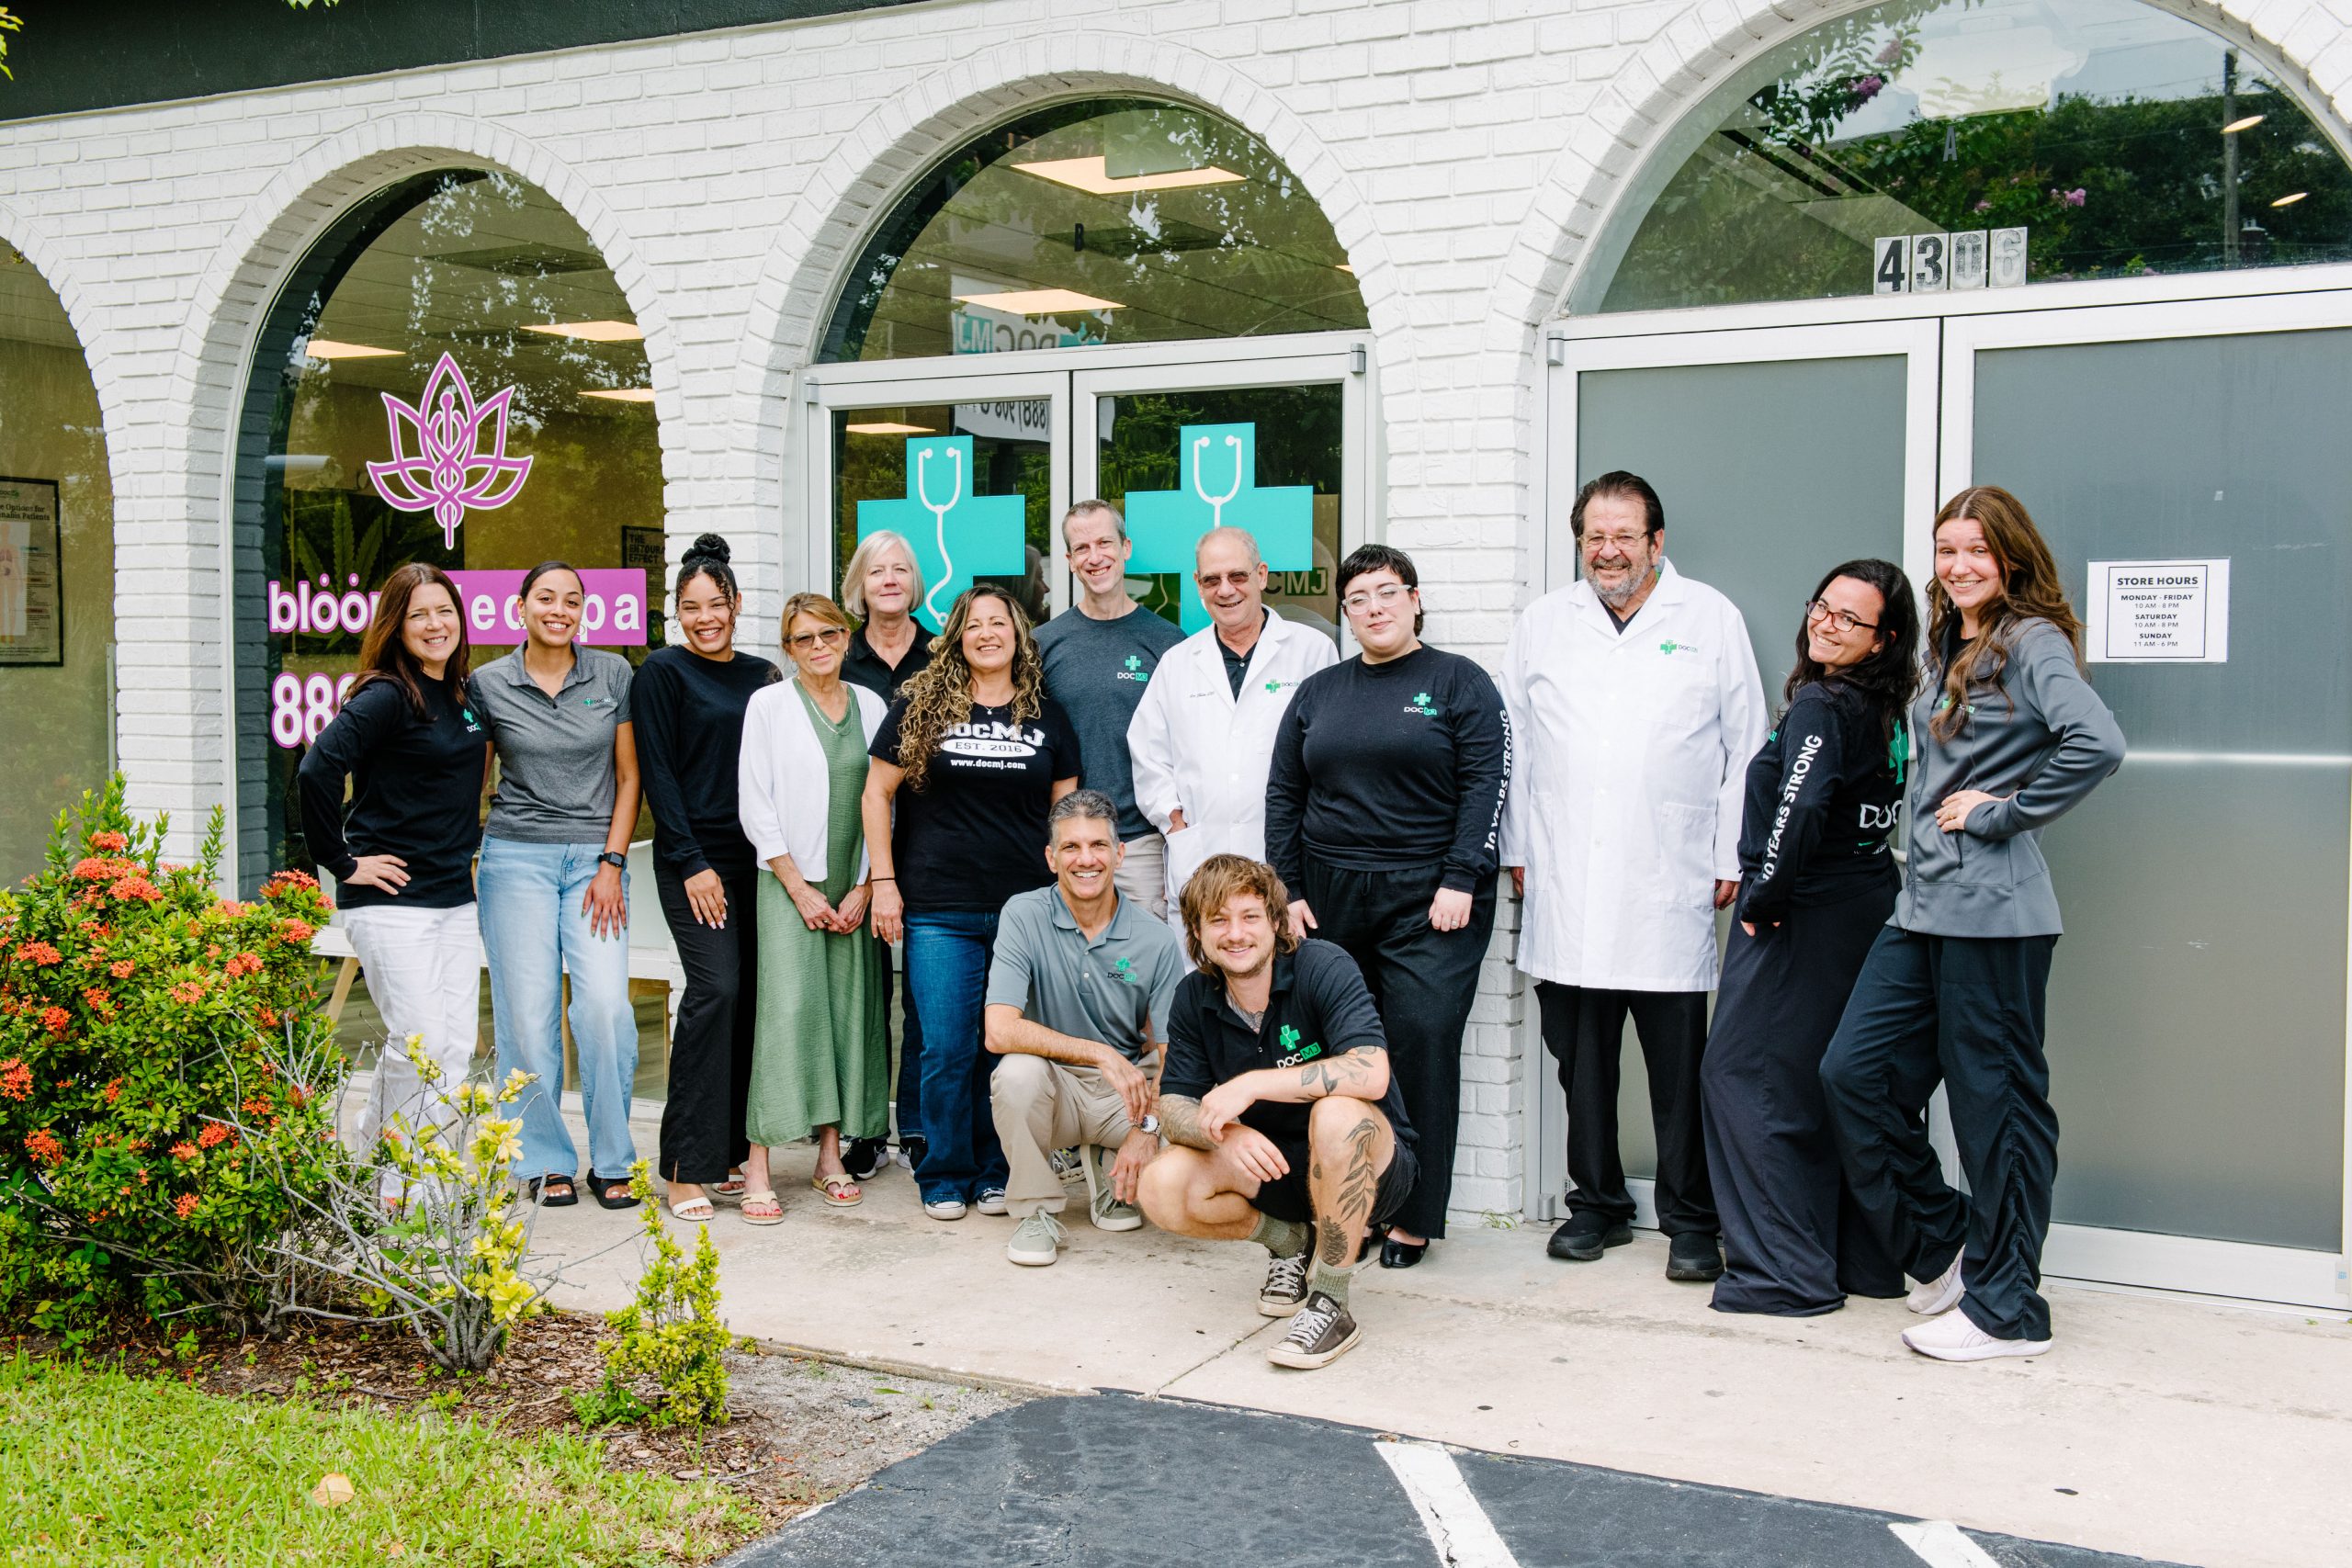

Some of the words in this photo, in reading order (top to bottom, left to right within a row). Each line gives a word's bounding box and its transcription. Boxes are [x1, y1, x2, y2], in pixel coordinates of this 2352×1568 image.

[1942, 125, 1958, 162] A
[1878, 230, 2021, 292] 4306
[2117, 577, 2154, 585] STORE
[2157, 577, 2199, 585] HOURS
[956, 741, 985, 750] EST.
[989, 743, 1023, 753] 2016
[1499, 709, 1512, 778] STRONG
[950, 759, 1026, 770] www.docmj.com
[1767, 805, 1791, 860] YEARS
[1783, 734, 1823, 804] STRONG
[1276, 1042, 1321, 1069] DOCMJ
